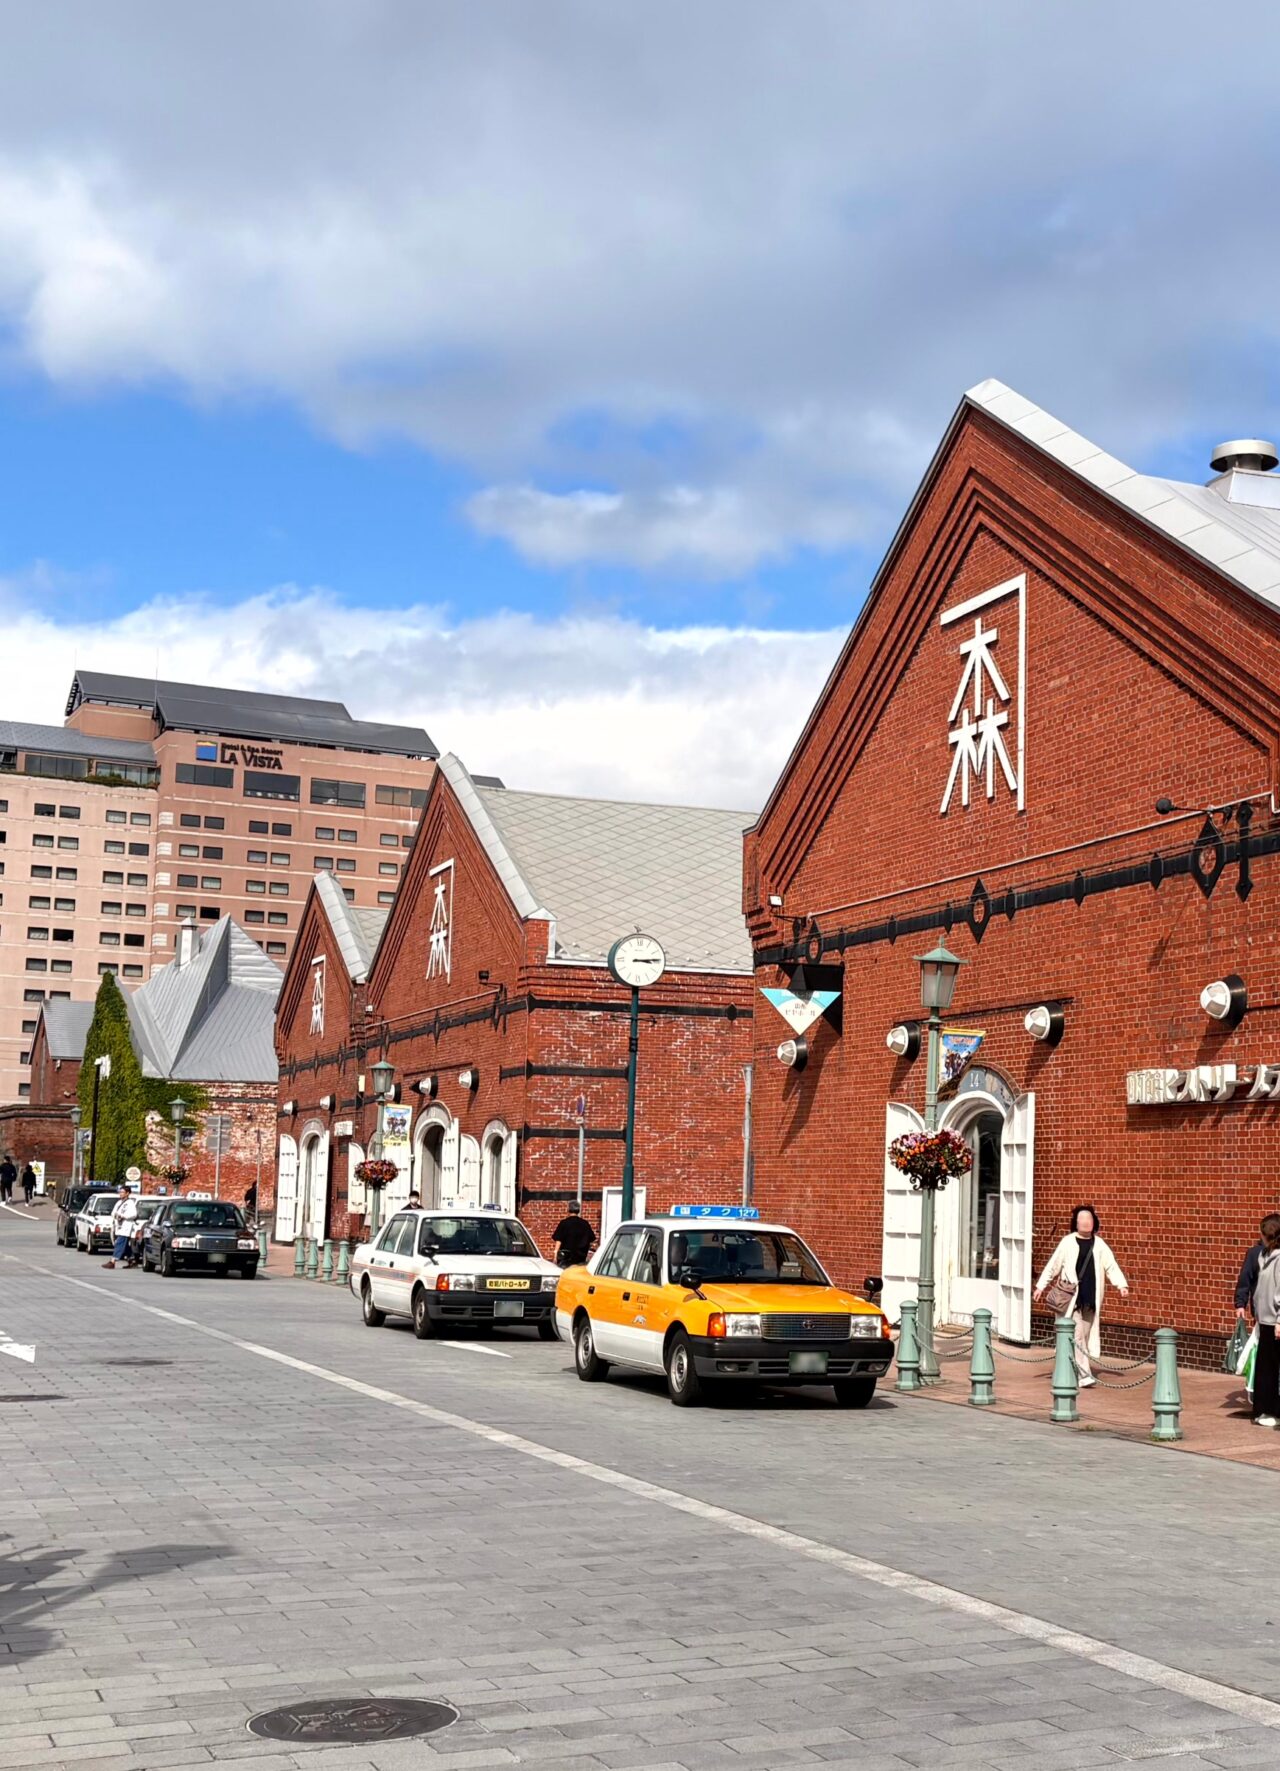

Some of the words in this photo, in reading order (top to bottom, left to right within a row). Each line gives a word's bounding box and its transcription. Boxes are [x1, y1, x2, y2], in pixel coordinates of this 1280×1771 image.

[221, 749, 238, 765] LA
[242, 751, 283, 769] VISTA
[738, 1209, 755, 1217] 127
